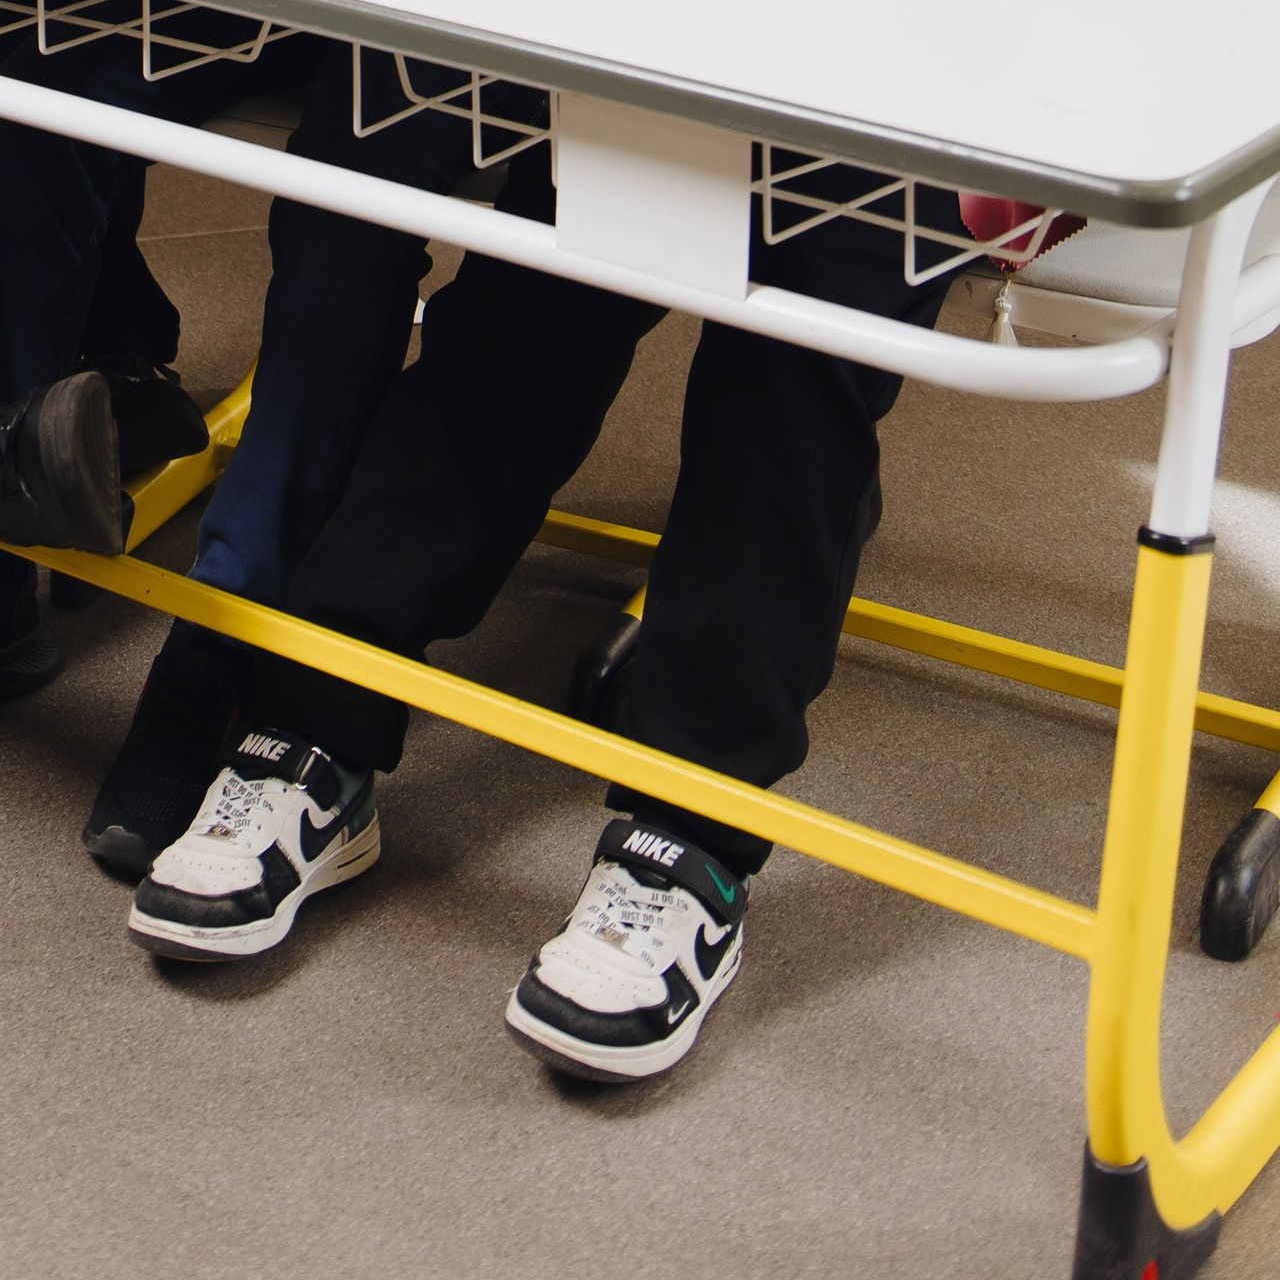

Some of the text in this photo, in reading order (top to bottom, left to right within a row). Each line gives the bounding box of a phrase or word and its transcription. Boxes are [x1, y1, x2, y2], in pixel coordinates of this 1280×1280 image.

[237, 733, 291, 762] NIKE
[622, 829, 685, 867] NIKE
[621, 910, 640, 922] JUST
[643, 913, 655, 925] DO
